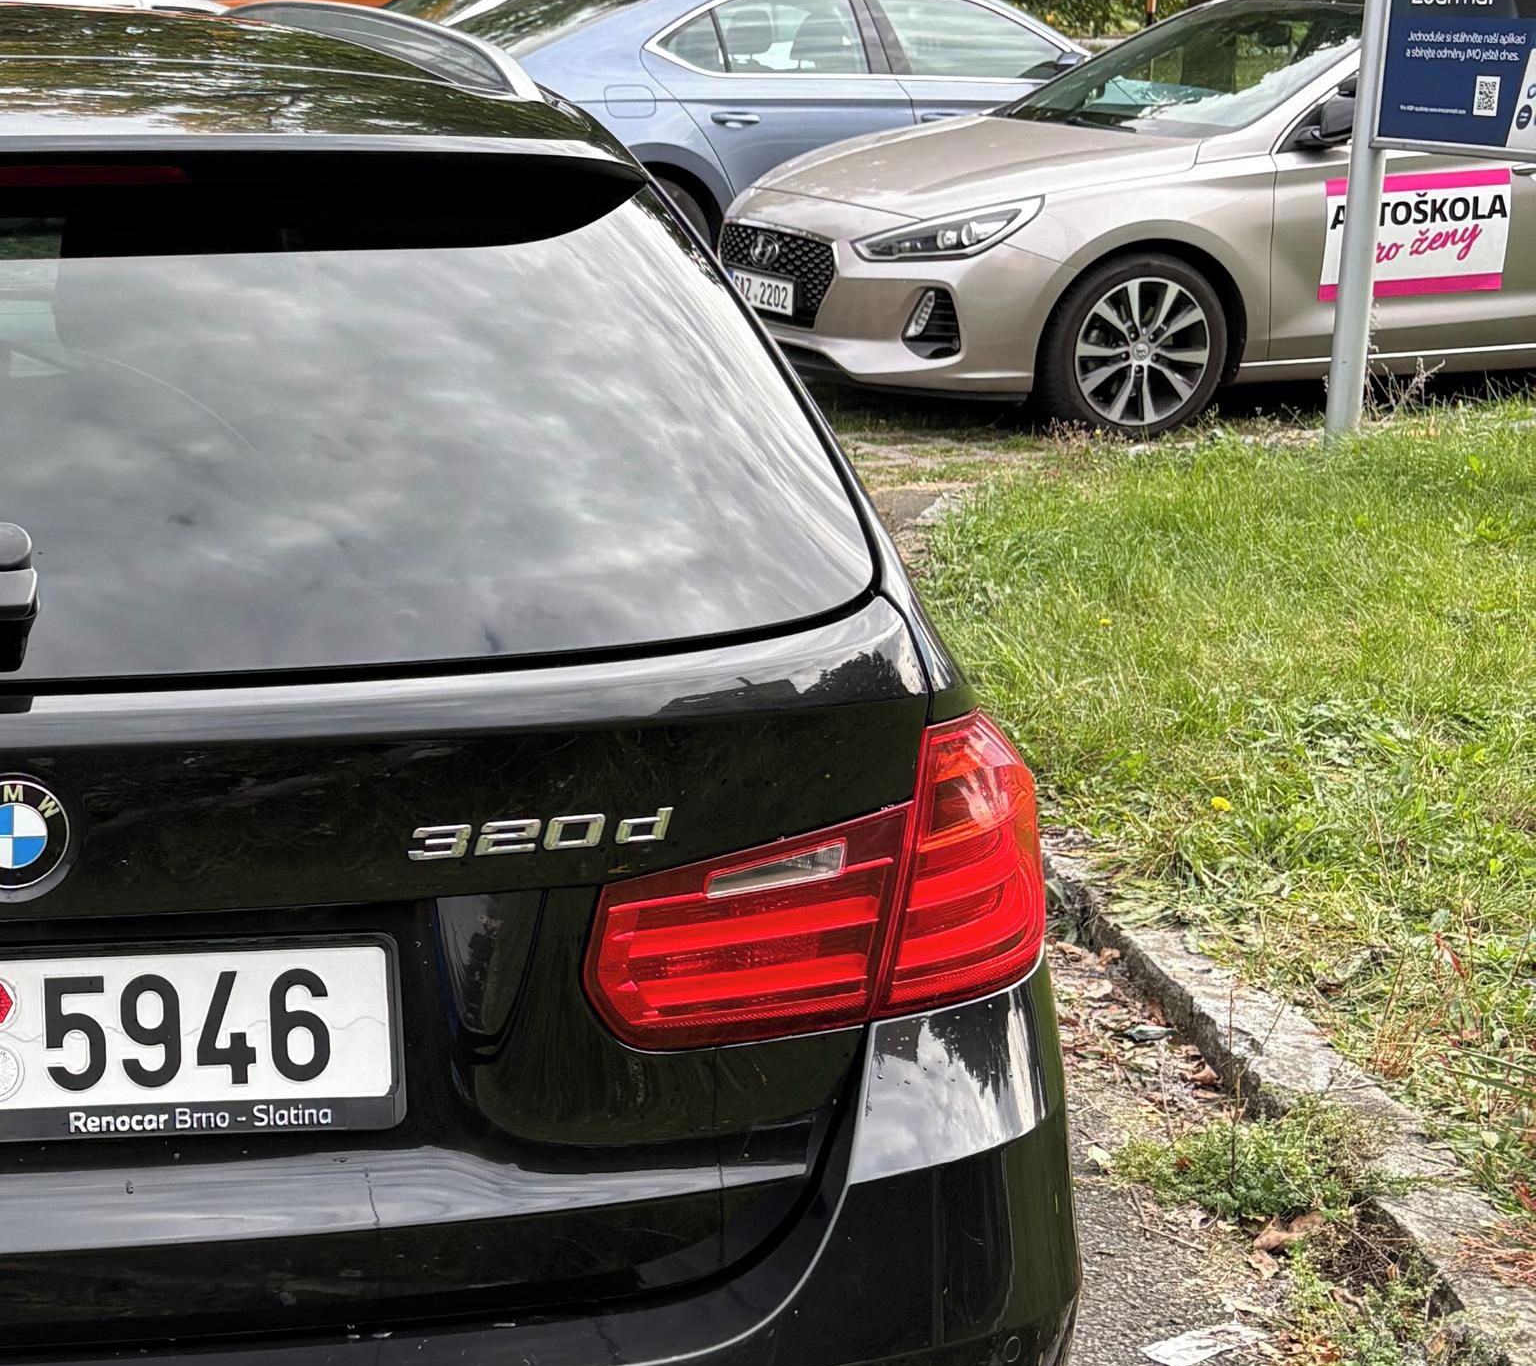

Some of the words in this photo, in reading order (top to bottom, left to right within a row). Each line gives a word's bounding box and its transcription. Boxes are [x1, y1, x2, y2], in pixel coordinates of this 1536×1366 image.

[1330, 192, 1508, 230] ATOŠKOLA
[1375, 242, 1404, 264] ro
[1409, 223, 1483, 261] ženy
[759, 281, 788, 310] 2202
[407, 806, 674, 861] 320d
[43, 967, 331, 1092] 5946
[69, 1111, 169, 1133] Renocar
[175, 1107, 230, 1130] Brno
[253, 1104, 333, 1127] Slatina
